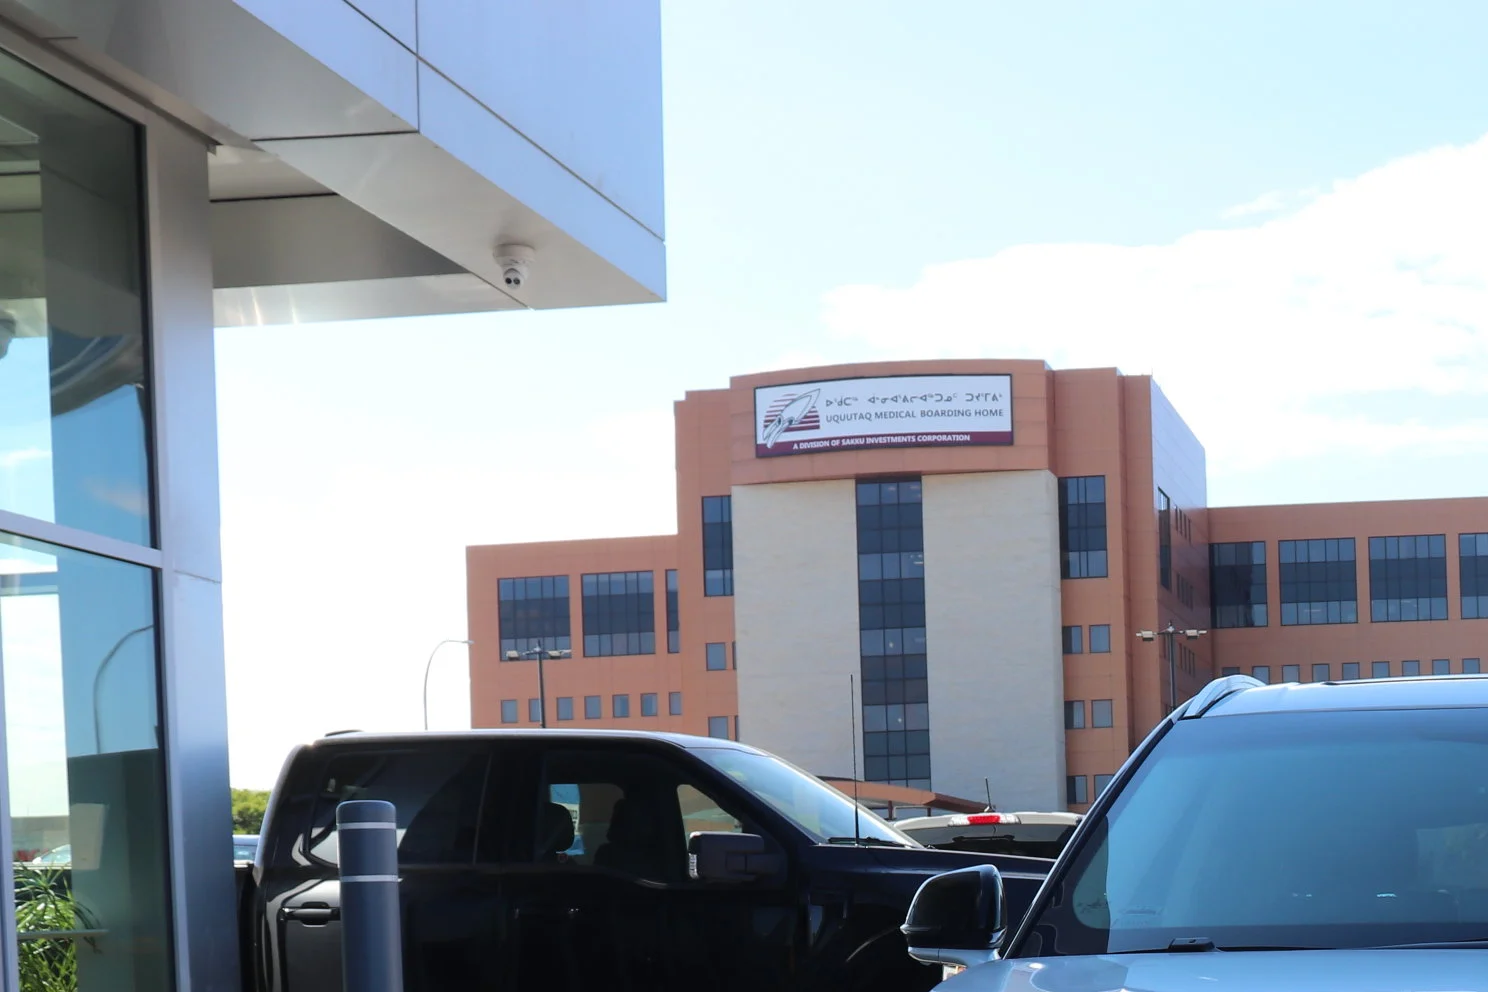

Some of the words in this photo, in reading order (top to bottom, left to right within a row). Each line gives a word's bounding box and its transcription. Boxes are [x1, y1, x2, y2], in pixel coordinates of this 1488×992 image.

[826, 412, 873, 424] UQUUTAQ
[874, 410, 916, 420] MEDICAL
[920, 409, 972, 418] BOARDING
[974, 408, 1004, 417] HOME
[799, 440, 830, 449] DIVISION
[831, 439, 840, 447] OF
[841, 437, 865, 446] SAKKU
[866, 435, 916, 445] INVESTMENTS
[917, 434, 971, 442] CORPORATION
